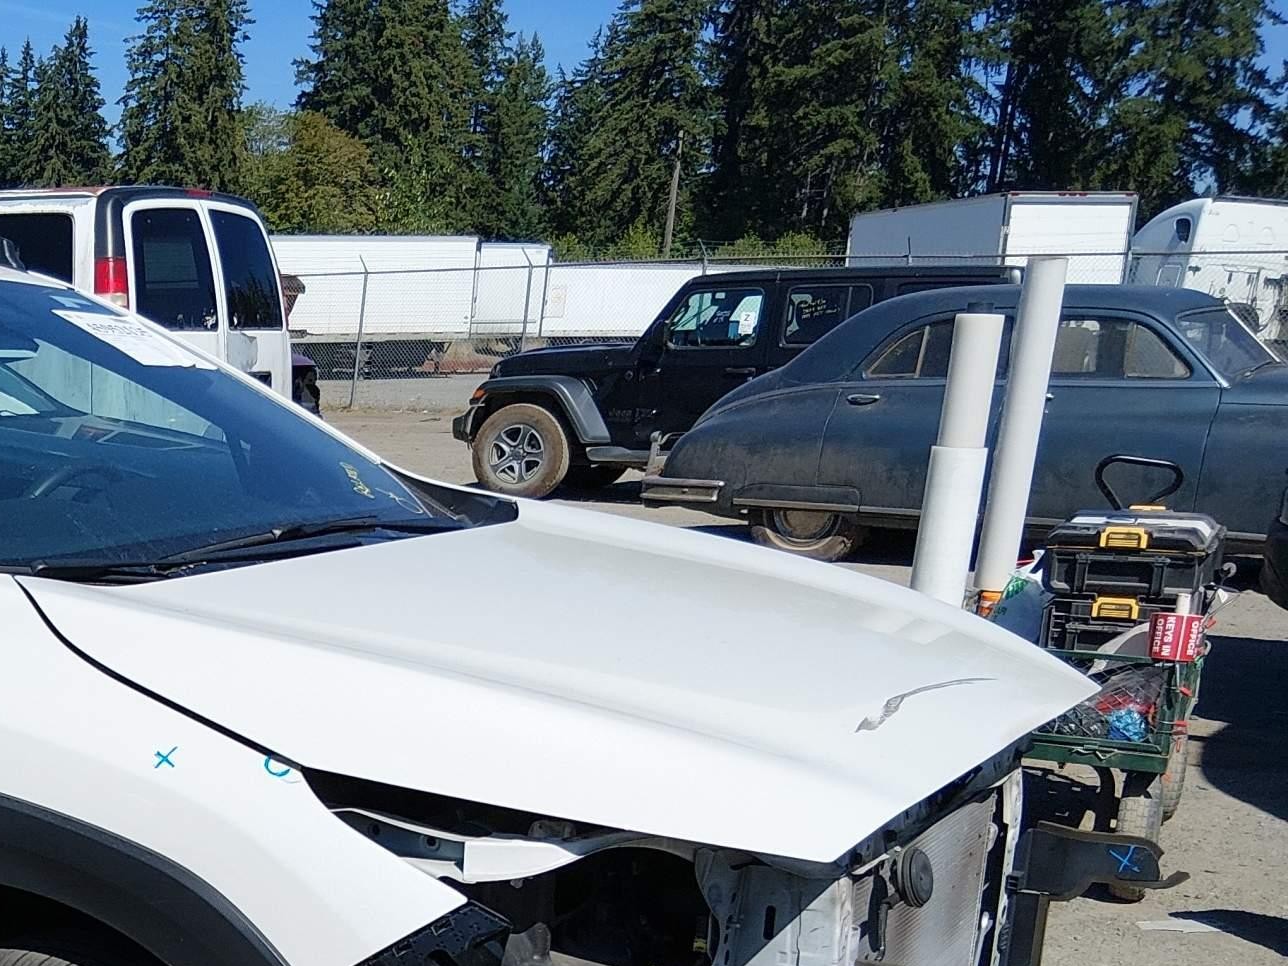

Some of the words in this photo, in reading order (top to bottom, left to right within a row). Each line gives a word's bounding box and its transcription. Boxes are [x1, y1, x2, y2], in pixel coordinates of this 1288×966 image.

[1152, 618, 1165, 653] OFFICE
[1163, 616, 1177, 643] KEYS
[1186, 620, 1200, 656] OFFICE
[1160, 645, 1171, 657] IN
